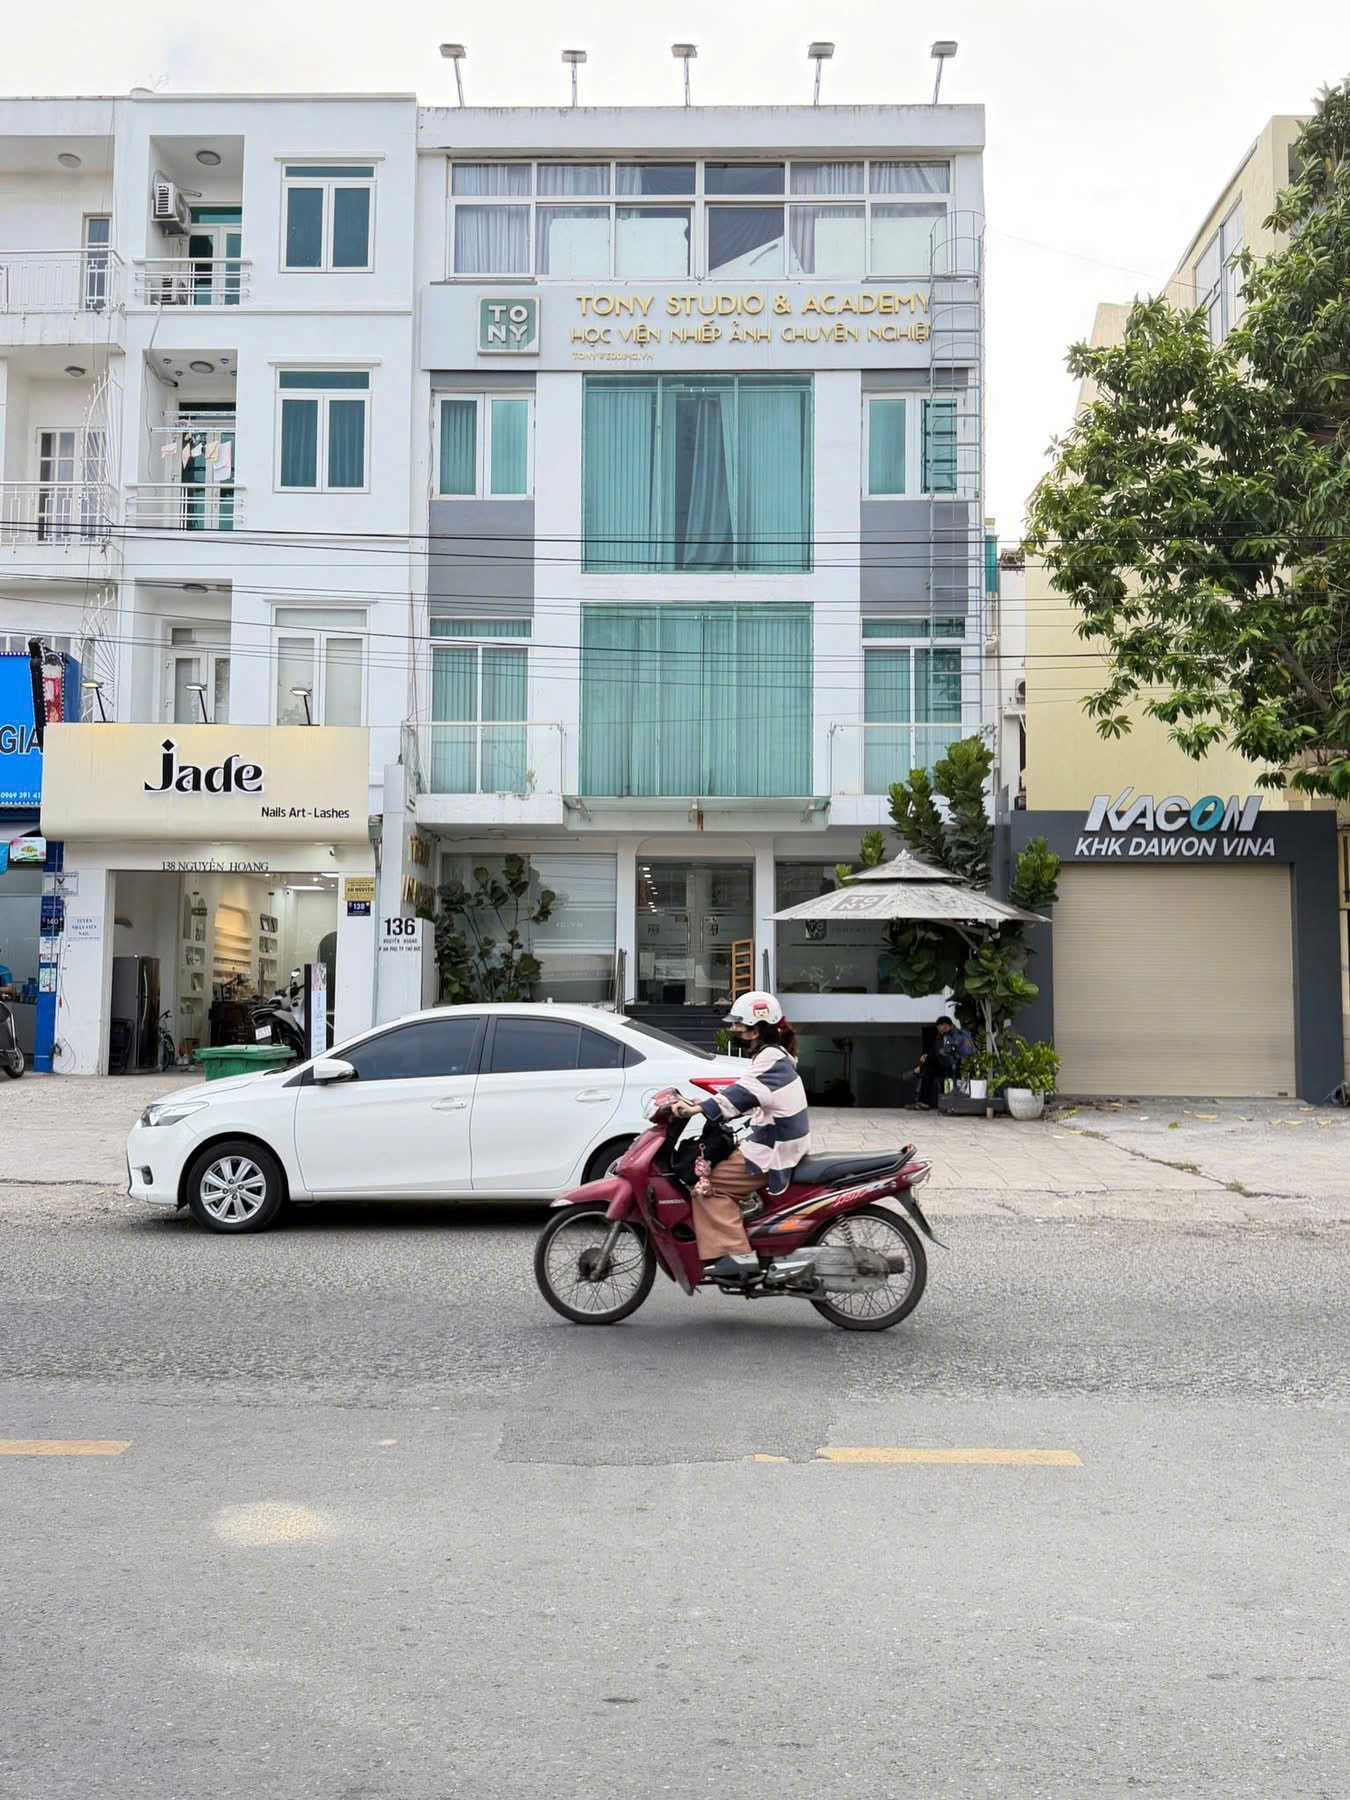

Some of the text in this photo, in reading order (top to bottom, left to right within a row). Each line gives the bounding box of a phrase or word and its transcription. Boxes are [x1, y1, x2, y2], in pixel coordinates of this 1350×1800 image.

[577, 292, 931, 316] TONY STUDIO & ACADEMY
[487, 305, 529, 323] TO
[487, 324, 529, 343] NY
[570, 327, 611, 347] HỌC
[618, 324, 661, 347] VIỆN
[670, 319, 722, 344] NHIẾP
[729, 320, 771, 344] ẢNH
[781, 323, 859, 343] CHUYÊN
[261, 806, 286, 818] Nails
[289, 807, 306, 818] Art
[313, 807, 350, 819] Lashes
[1074, 837, 1276, 857] KHK DAWON VINA
[162, 861, 176, 871] 138
[384, 918, 415, 936] 136
